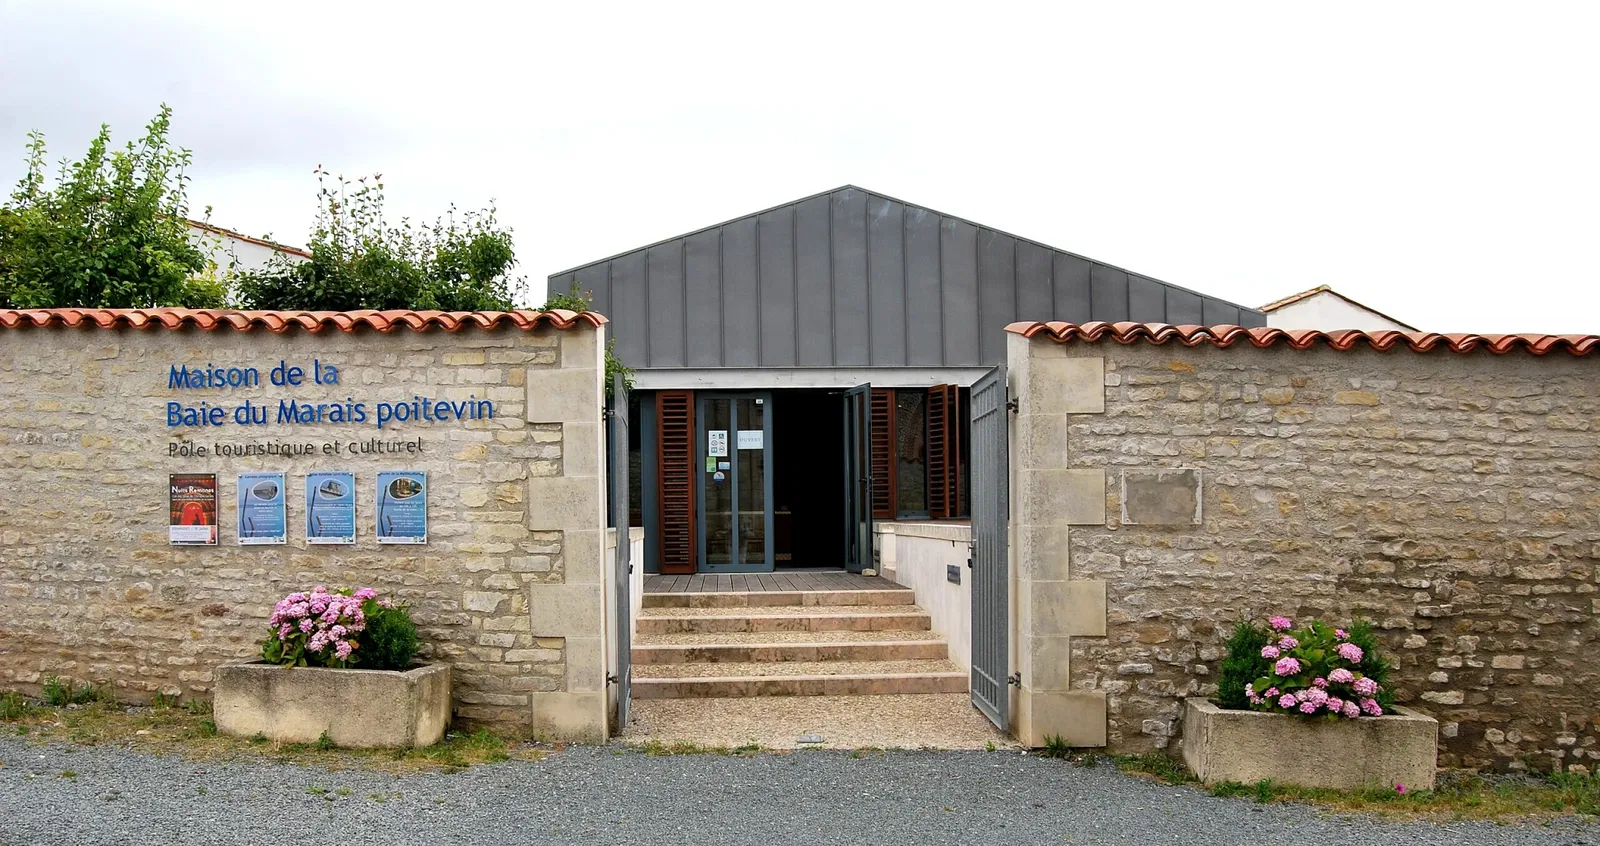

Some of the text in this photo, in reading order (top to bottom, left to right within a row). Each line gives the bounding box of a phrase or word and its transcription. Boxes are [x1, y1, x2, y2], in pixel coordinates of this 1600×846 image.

[168, 359, 338, 389] Maison de la
[167, 394, 493, 429] Baie du Marais poitevin
[168, 437, 424, 459] Pôle touristique et culturel
